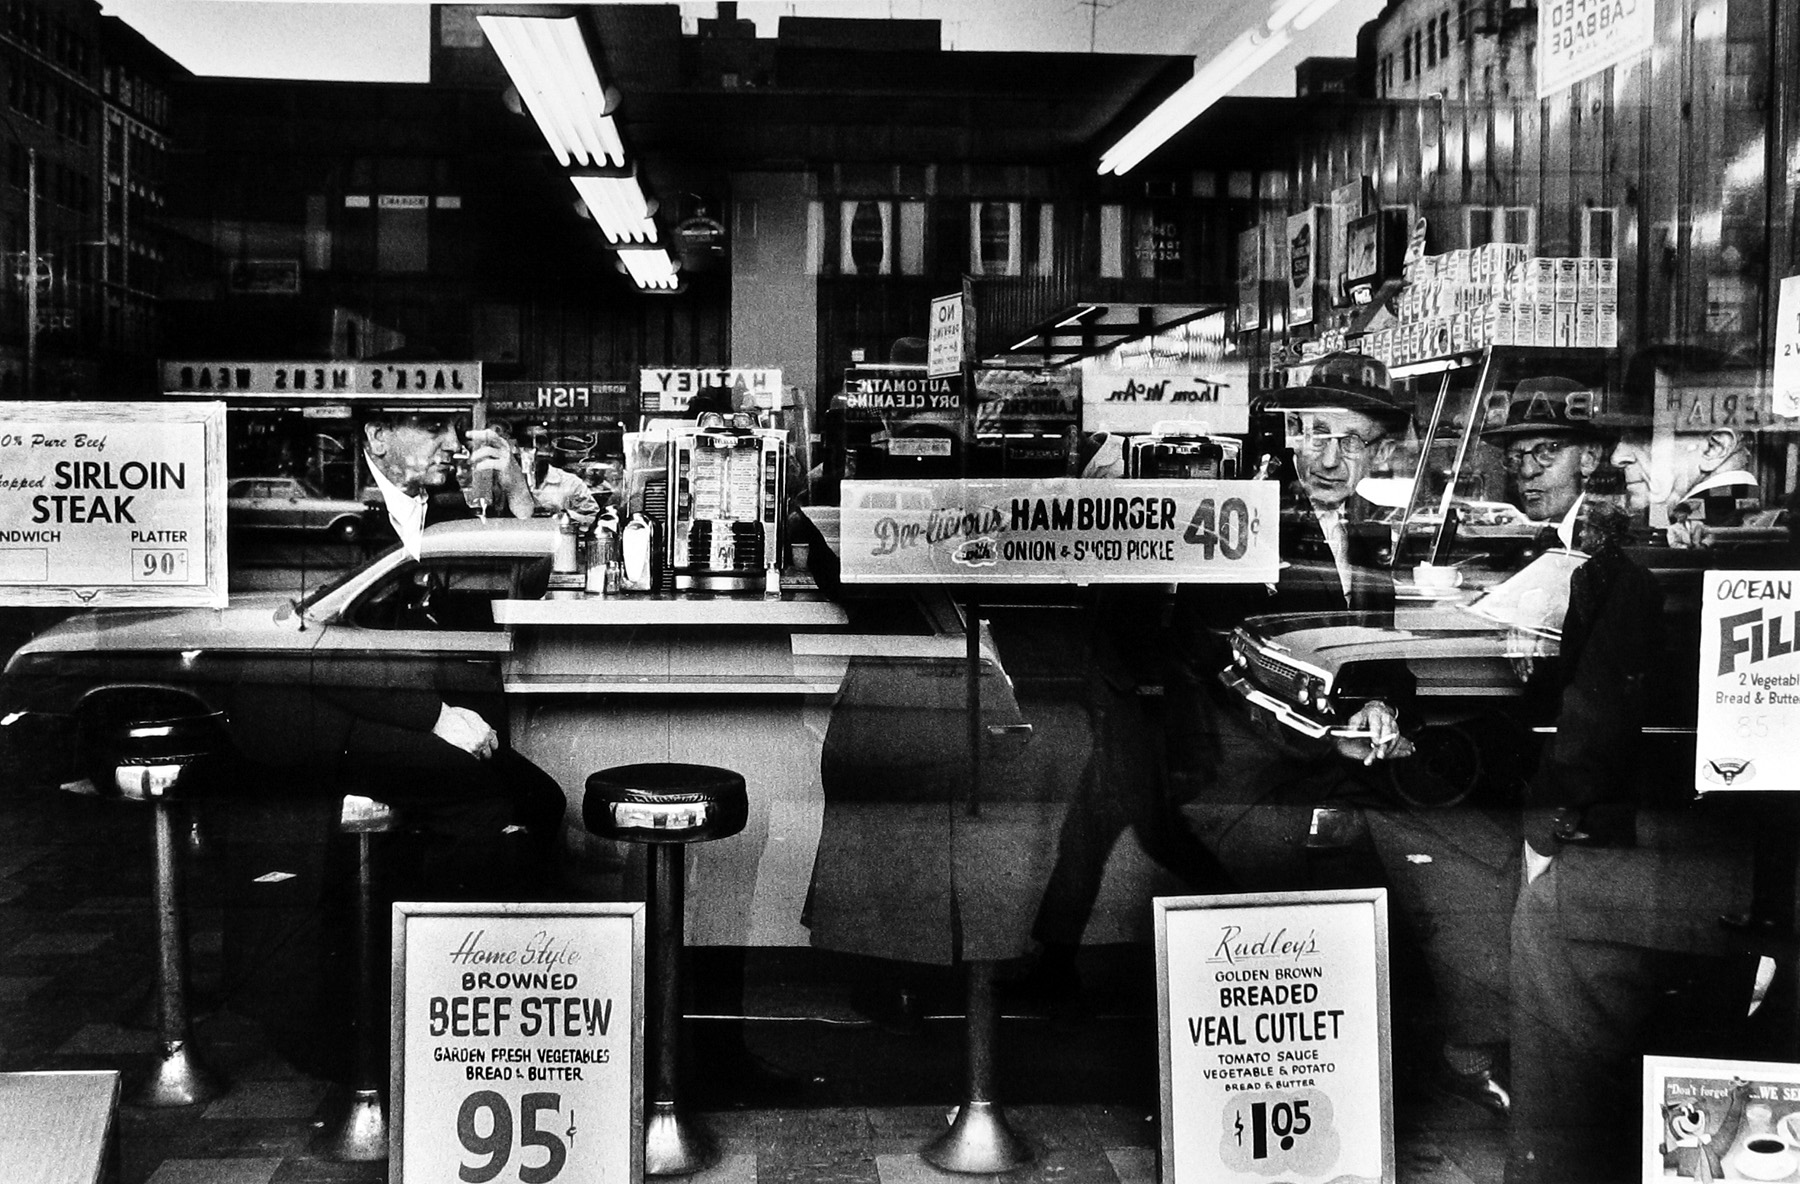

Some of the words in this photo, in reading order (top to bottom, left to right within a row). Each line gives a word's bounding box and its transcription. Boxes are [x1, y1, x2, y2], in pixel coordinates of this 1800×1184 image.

[31, 434, 67, 448] Pure
[74, 433, 108, 452] Beef
[54, 461, 186, 490] SIRLOIN
[31, 495, 136, 524] STEAK
[0, 530, 61, 542] NDWICH
[131, 530, 188, 543] PLATTER
[1011, 496, 1176, 531] HAMBURGER
[1183, 497, 1260, 560] 40¢
[1003, 540, 1056, 561] ONION
[1060, 545, 1071, 558] &
[1127, 540, 1175, 560] PICKLE
[1717, 578, 1792, 600] OCEAN
[1738, 673, 1747, 686] 2
[1715, 691, 1751, 705] Bread
[1754, 691, 1765, 704] &
[450, 929, 517, 965] Home
[520, 930, 582, 972] Style
[1214, 925, 1320, 965] Rudley's
[462, 972, 578, 990] BROWNED
[1215, 969, 1269, 982] GOLDEN
[1275, 967, 1323, 980] BROWN
[1220, 983, 1318, 1008] BREADED
[429, 996, 513, 1037] BEEF
[520, 996, 613, 1037] STEW
[1188, 1015, 1247, 1046] VEAL
[1255, 1009, 1345, 1043] CUTLET
[433, 1047, 485, 1063] GARDEN
[491, 1048, 531, 1063] FRESH
[538, 1047, 610, 1063] VEGETABLES
[1218, 1052, 1270, 1065] TOMATO
[1277, 1050, 1319, 1062] SAUCE
[466, 1066, 512, 1081] BREAD
[528, 1066, 584, 1081] BUTTER
[1203, 1066, 1274, 1079] VEGETABLE
[1279, 1066, 1288, 1076] &
[1292, 1063, 1335, 1075] POTATO
[1225, 1082, 1261, 1092] BREAD
[1265, 1081, 1273, 1090] &
[1276, 1079, 1316, 1089] BUTTER
[1700, 1085, 1729, 1099] forget
[457, 1089, 577, 1184] 95¢
